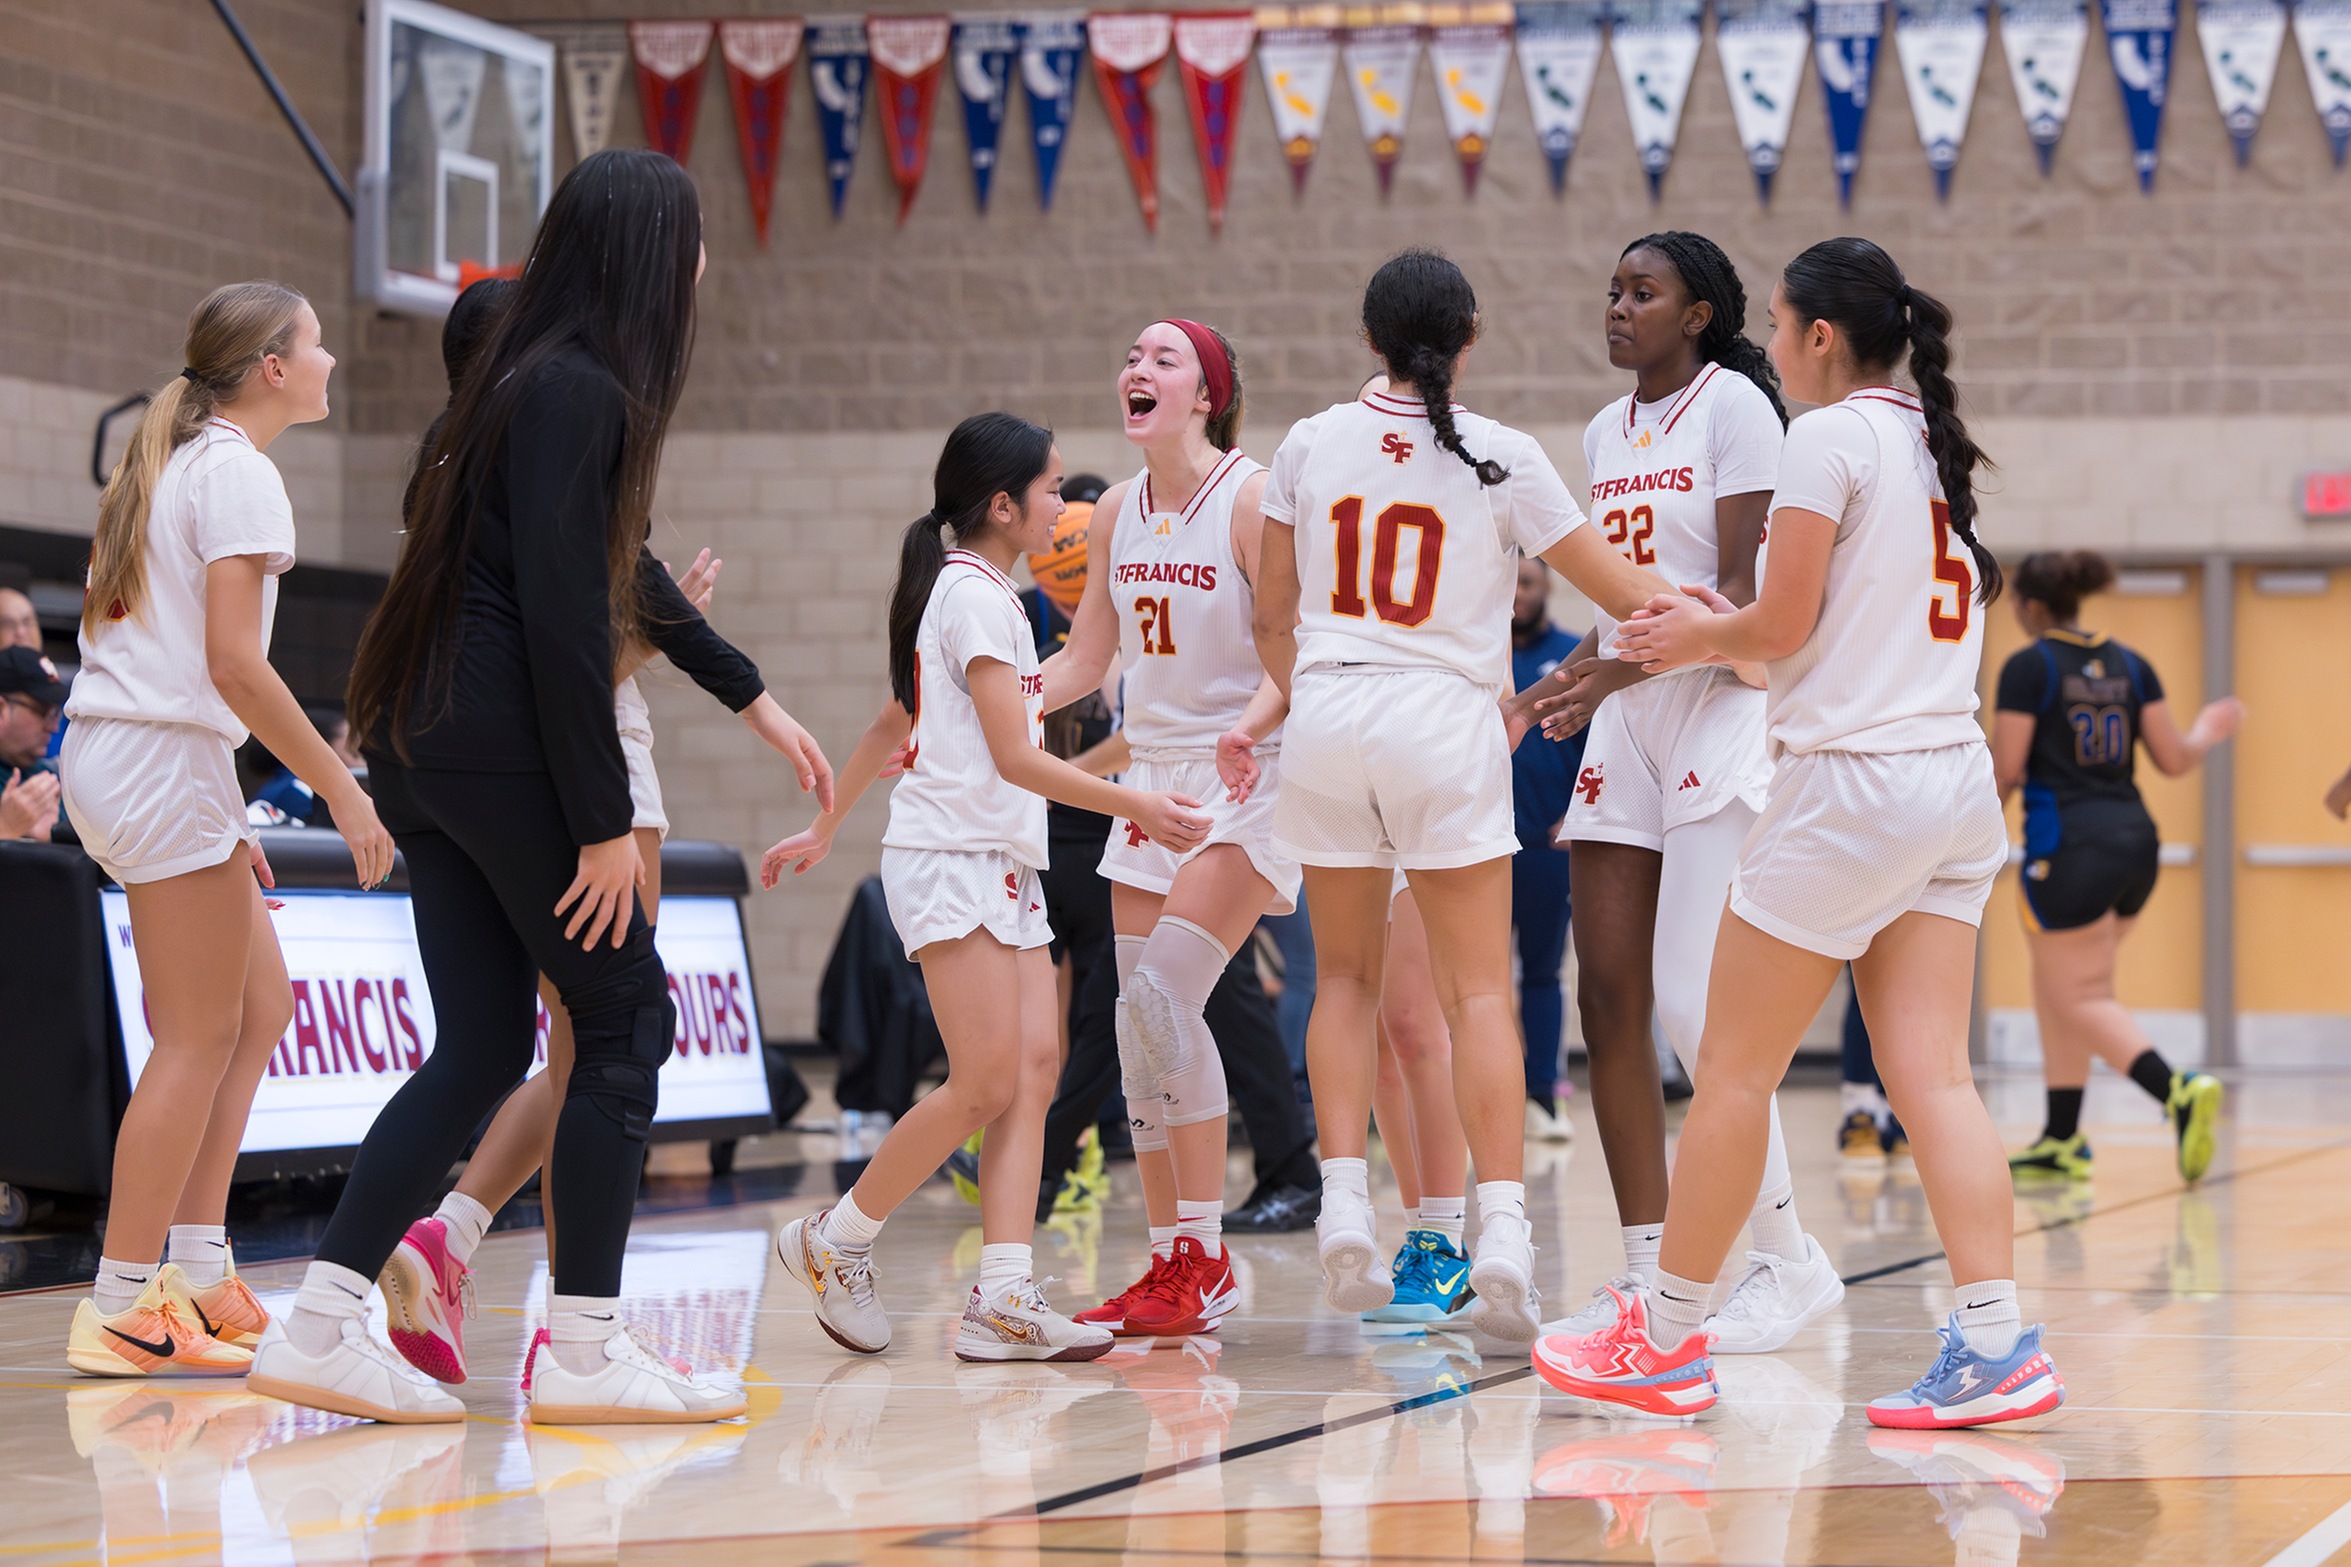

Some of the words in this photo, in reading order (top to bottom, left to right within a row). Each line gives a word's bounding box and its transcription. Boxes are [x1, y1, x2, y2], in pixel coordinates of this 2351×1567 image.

[1381, 432, 1414, 465] SF
[1328, 493, 1447, 630] 10
[1603, 504, 1656, 566] 22
[1928, 497, 1973, 644] 5
[1134, 595, 1177, 657] 21
[2067, 702, 2131, 767] 20
